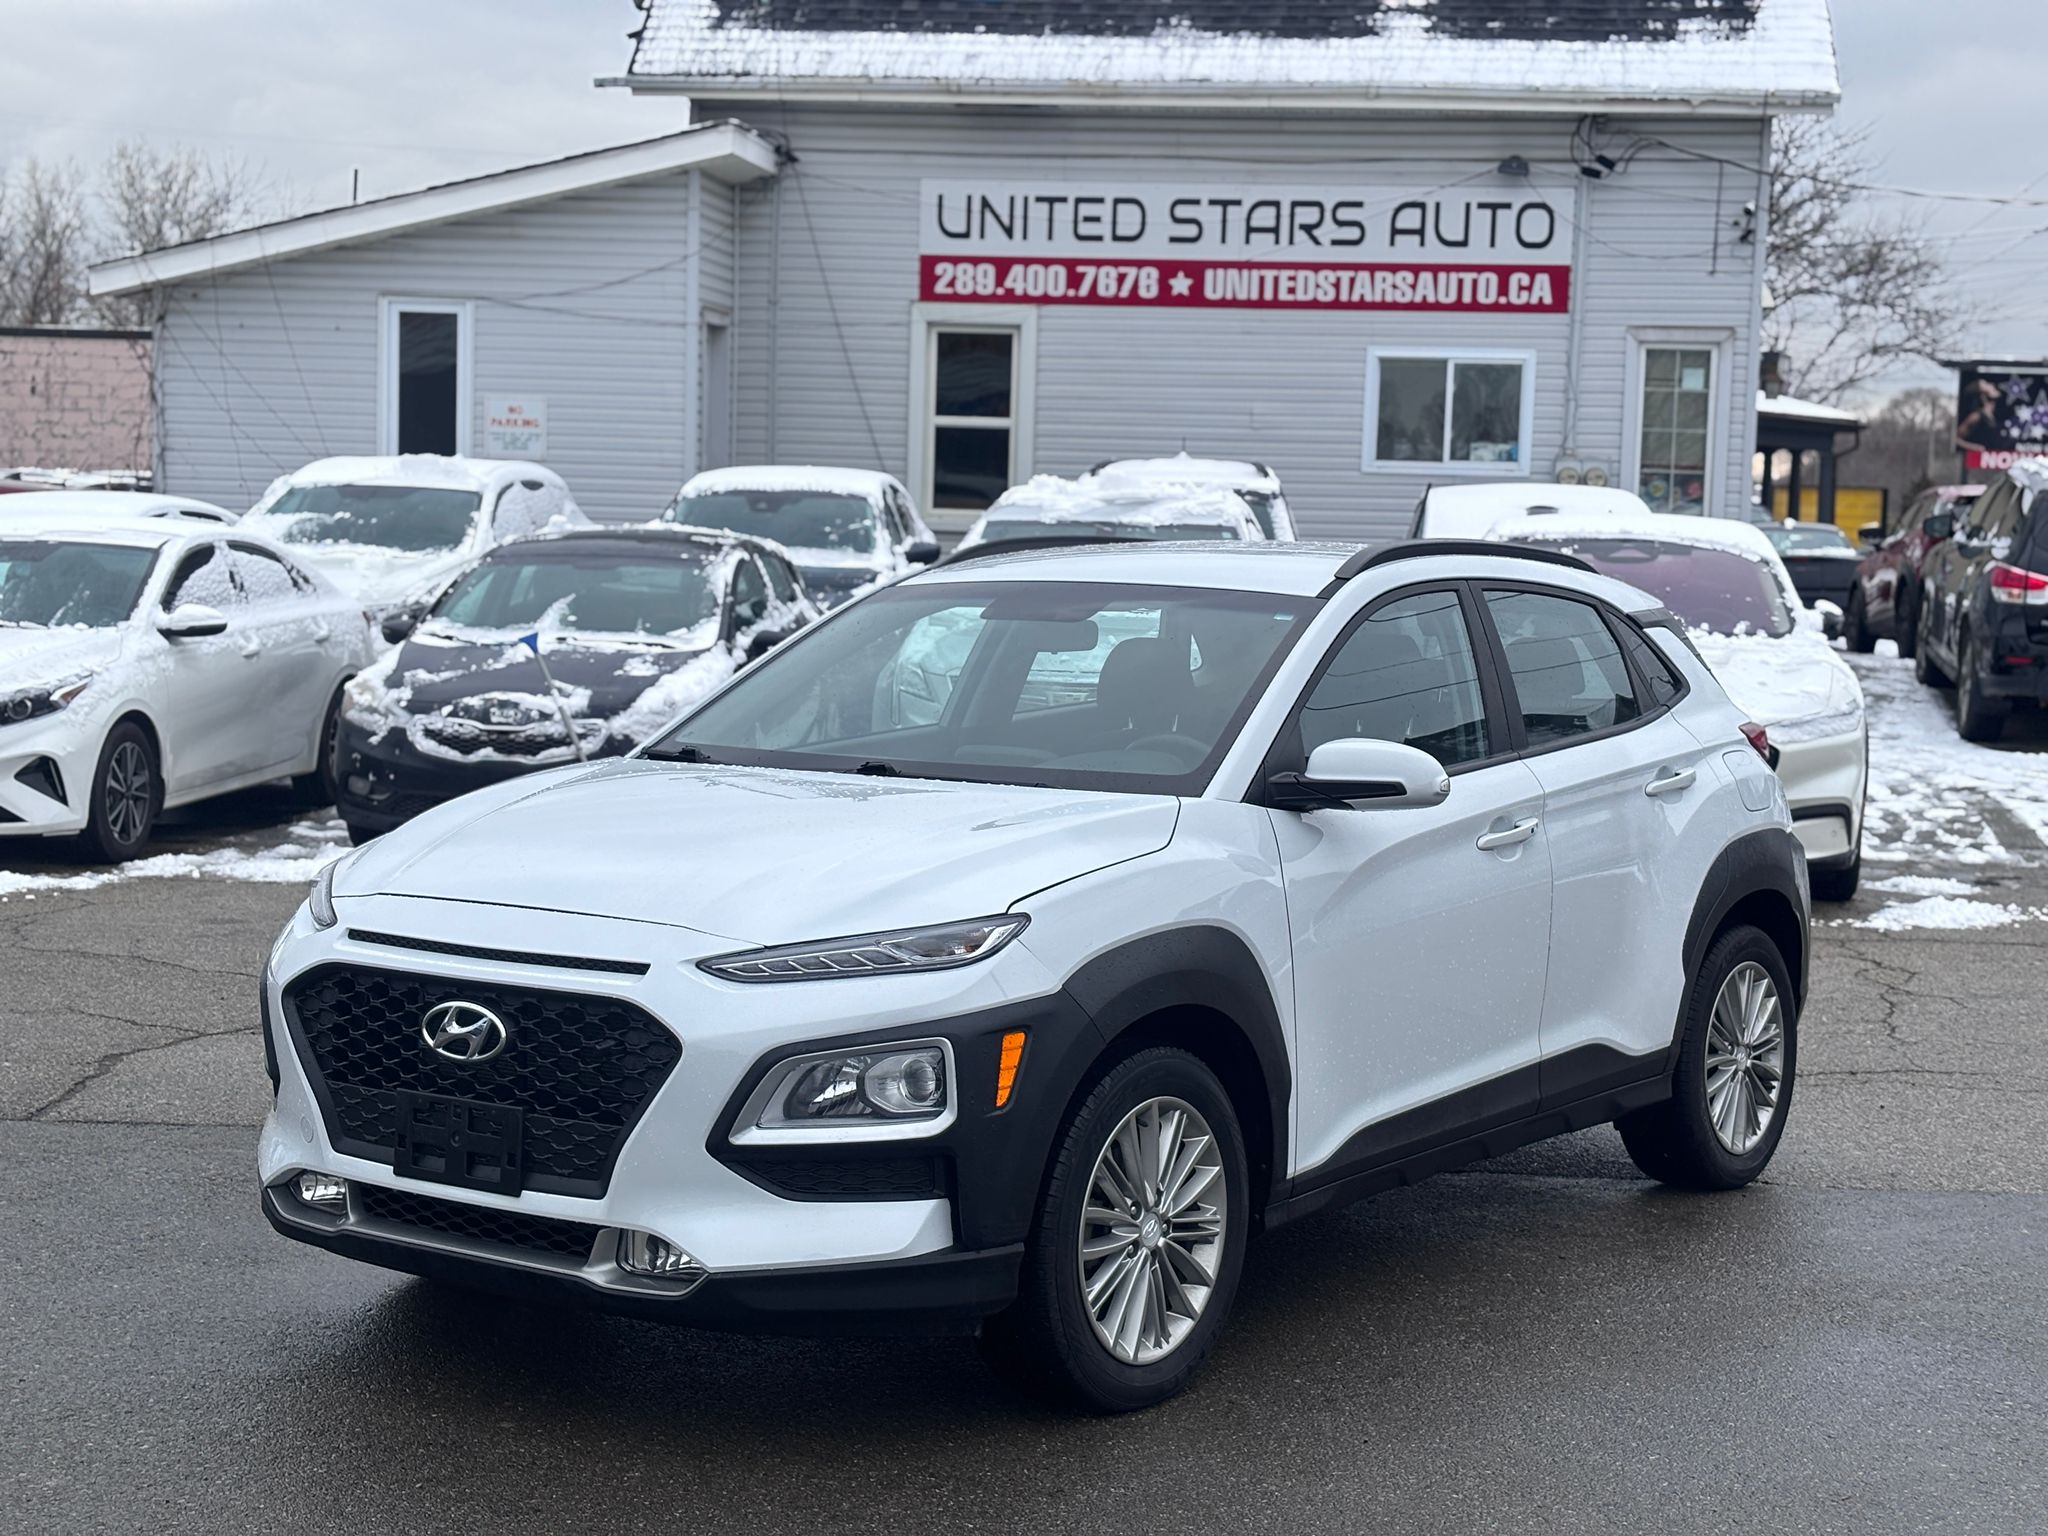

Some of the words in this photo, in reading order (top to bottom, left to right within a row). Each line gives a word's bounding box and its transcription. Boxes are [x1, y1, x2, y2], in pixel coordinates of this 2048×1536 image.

[937, 194, 1146, 241] UNITED
[1168, 198, 1365, 245] STARS
[1389, 201, 1555, 249] AUTO
[1203, 267, 1553, 305] UNITEDSTARSAUTO.CA
